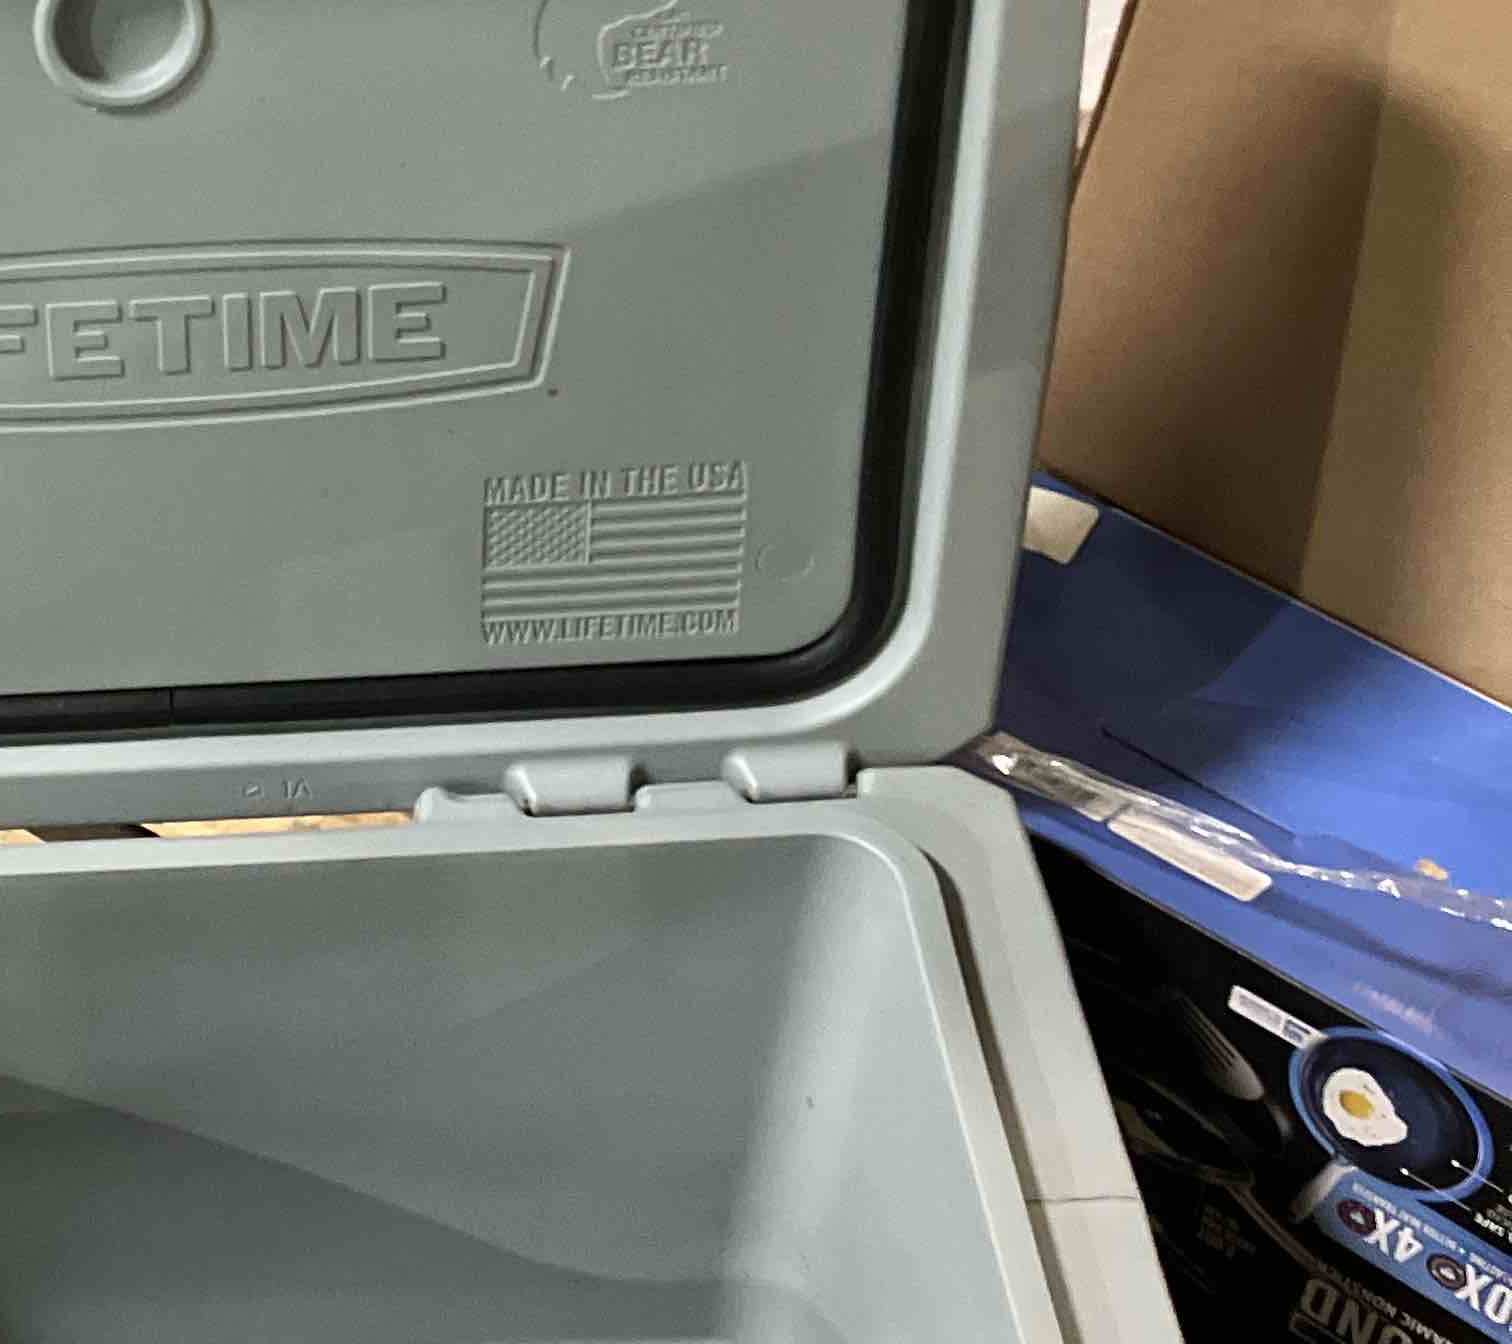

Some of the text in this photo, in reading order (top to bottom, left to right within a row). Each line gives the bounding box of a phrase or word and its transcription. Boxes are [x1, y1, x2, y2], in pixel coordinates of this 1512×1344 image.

[482, 459, 748, 505] MADE IN THE USA
[481, 608, 740, 646] WWW.LIFETIME.COM
[1363, 1207, 1426, 1264] 4X
[1455, 1262, 1512, 1327] 0X
